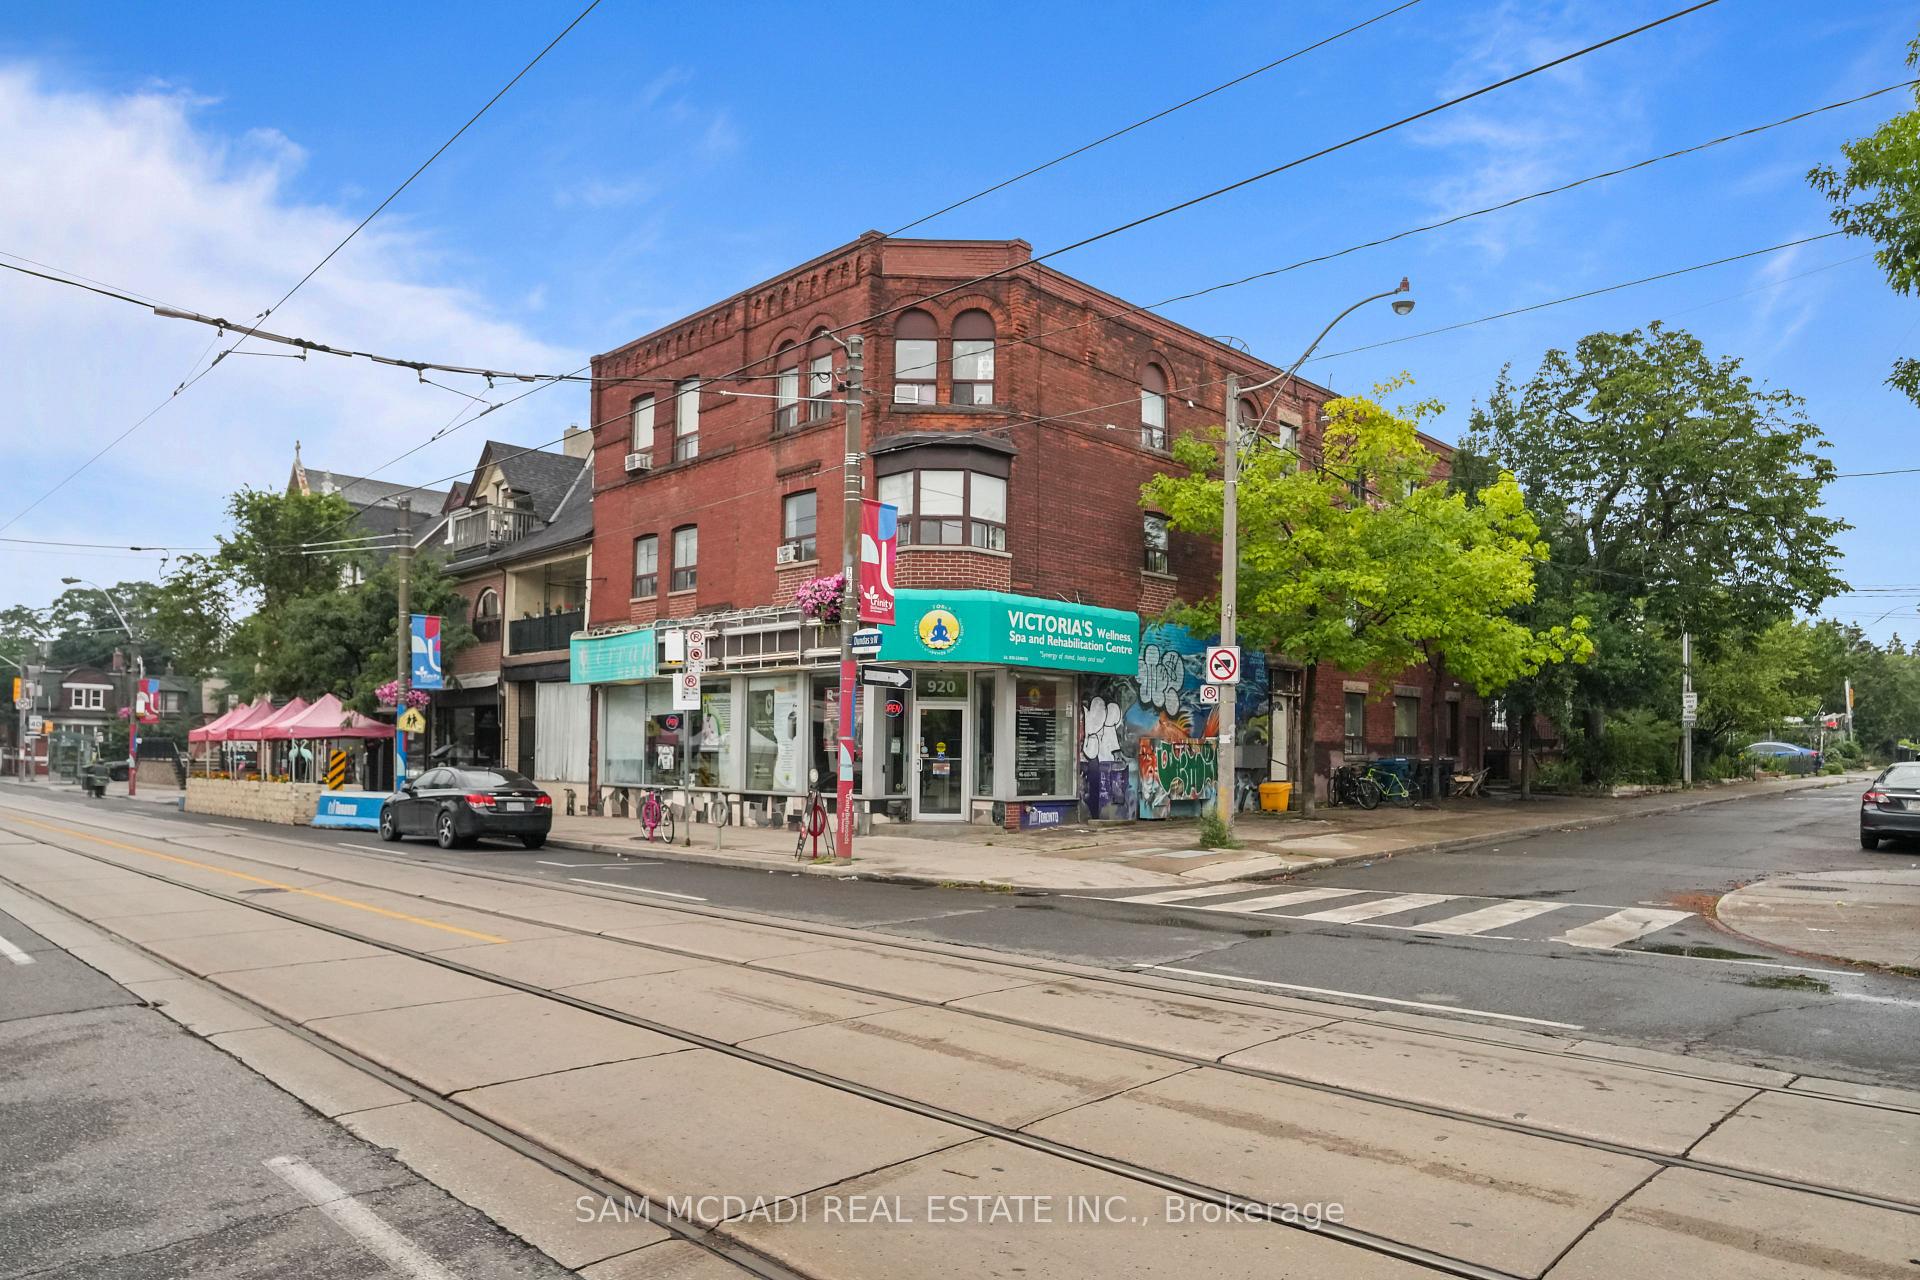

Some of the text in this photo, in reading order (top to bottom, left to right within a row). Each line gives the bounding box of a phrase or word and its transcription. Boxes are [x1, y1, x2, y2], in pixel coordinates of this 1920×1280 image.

[1007, 610, 1133, 643] VICTORIA'S Wellness,
[1009, 630, 1133, 655] Spa and Rehabilitation Centre
[927, 680, 956, 693] 920
